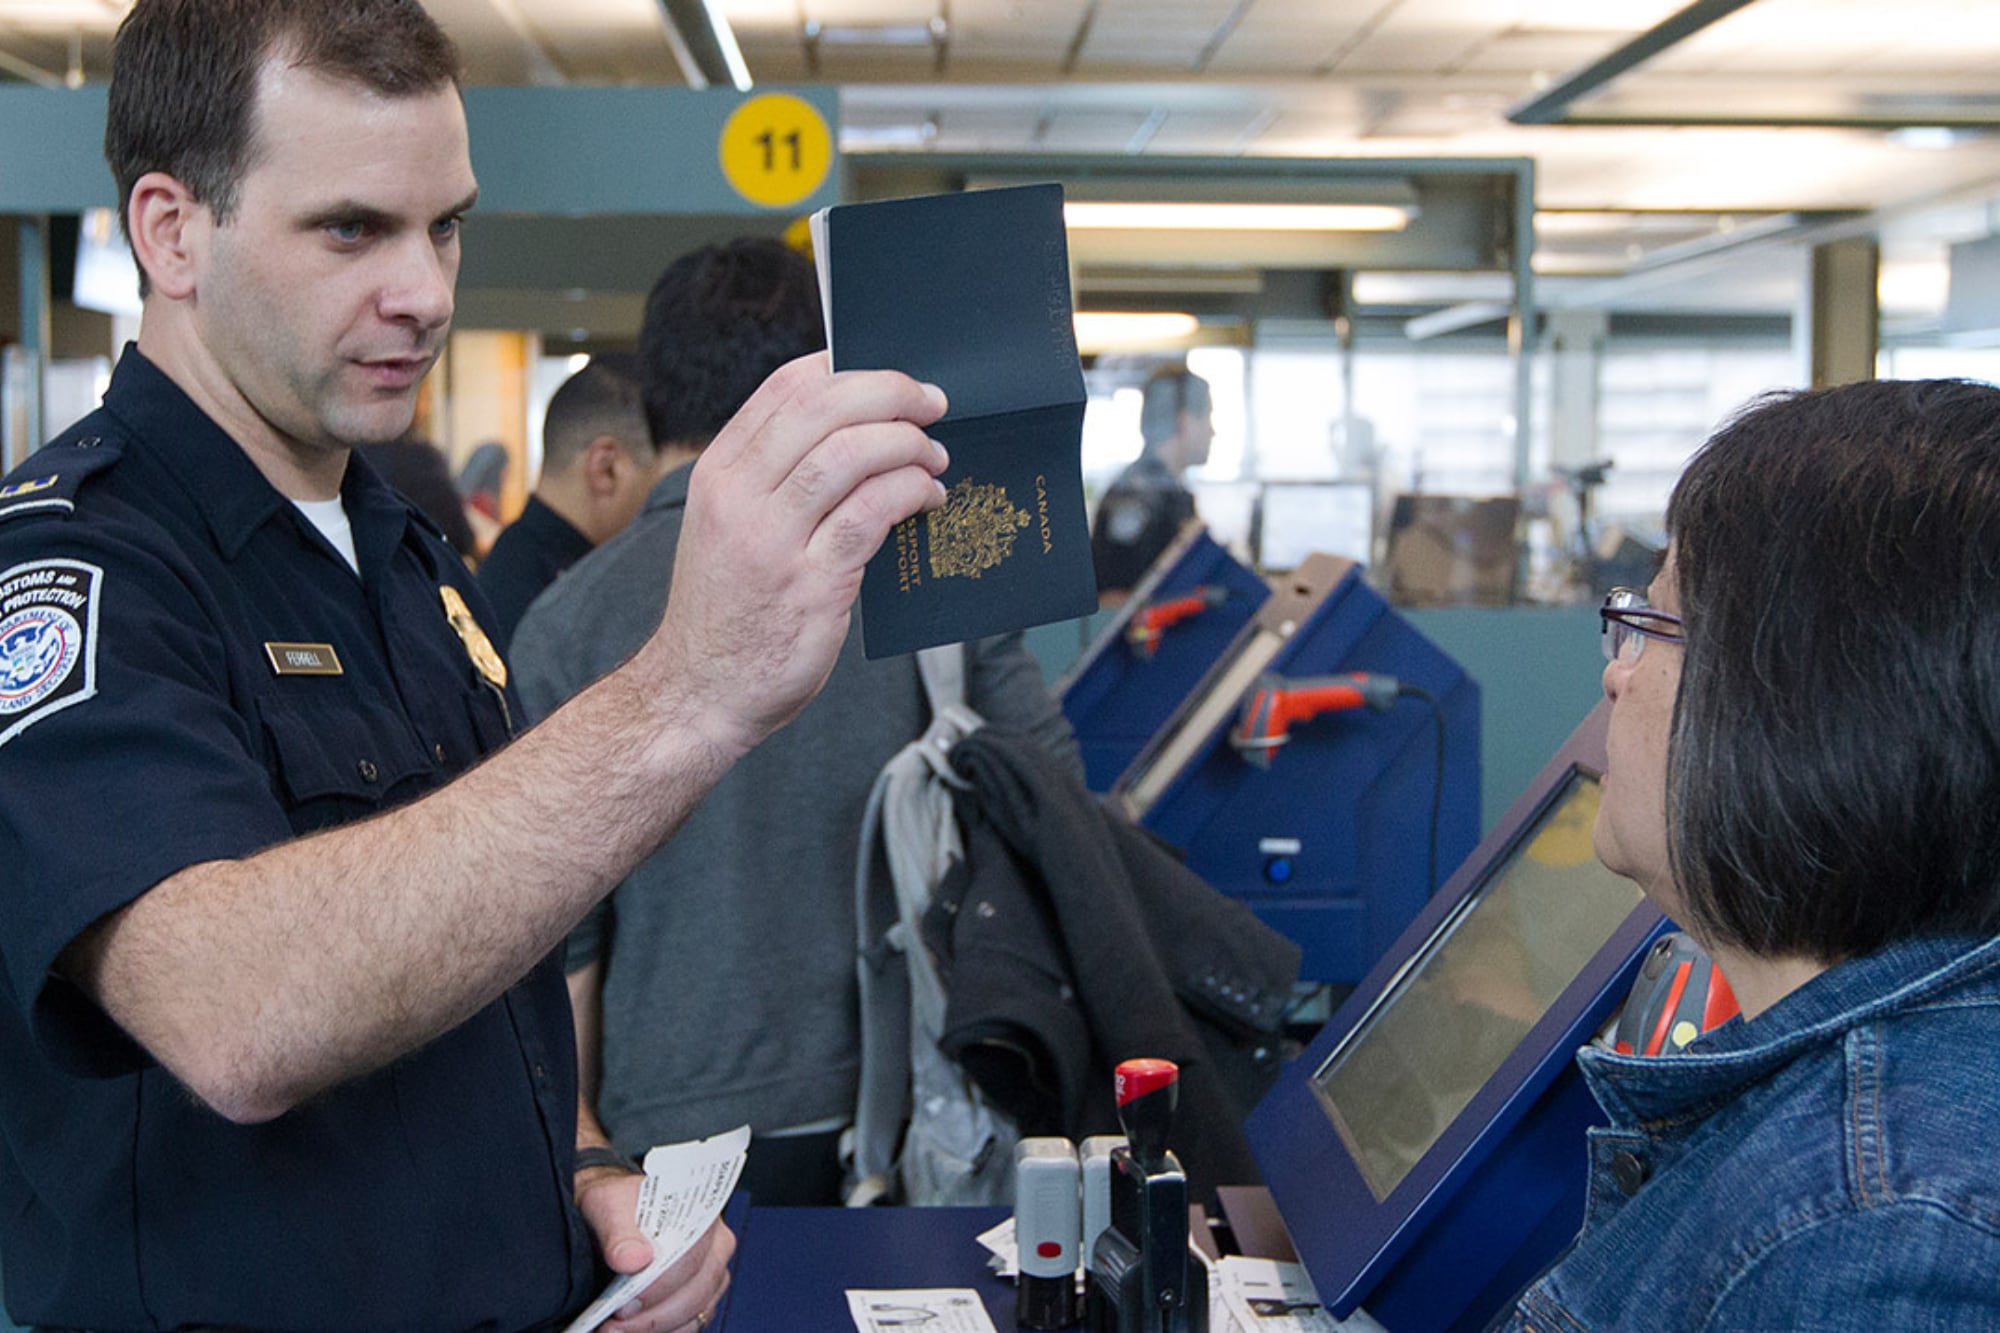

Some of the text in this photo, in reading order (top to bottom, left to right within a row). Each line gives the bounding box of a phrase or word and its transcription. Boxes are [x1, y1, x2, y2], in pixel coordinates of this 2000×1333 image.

[754, 127, 803, 171] 11
[1035, 474, 1053, 555] CANADA
[896, 523, 911, 592] SEPORT
[907, 517, 922, 586] SSPORT
[0, 570, 56, 600] STOMS
[3, 587, 87, 613] PROTECTION
[0, 695, 33, 710] LAND
